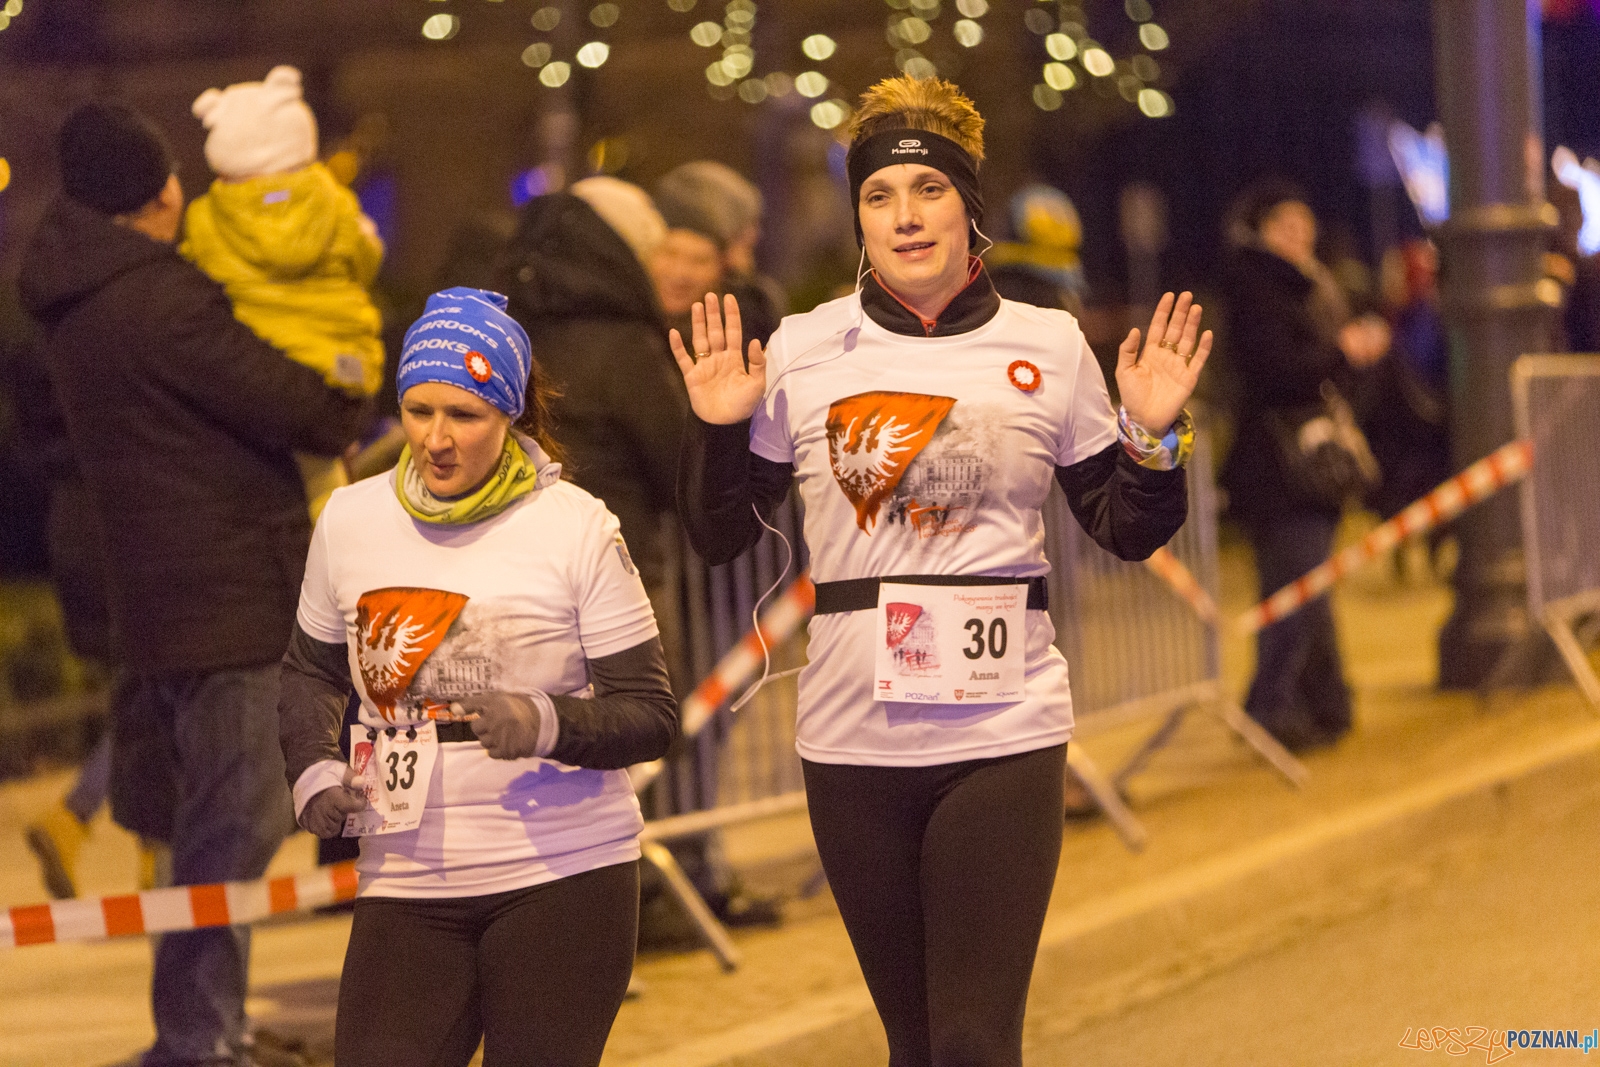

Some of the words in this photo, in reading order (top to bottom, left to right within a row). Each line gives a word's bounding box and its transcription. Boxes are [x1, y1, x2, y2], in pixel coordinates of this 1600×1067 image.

[891, 147, 929, 156] Kalenji
[416, 319, 499, 349] BROOKS
[962, 617, 1008, 660] 30
[969, 670, 1000, 681] Anna
[385, 750, 419, 792] 33
[390, 801, 410, 812] Aneta
